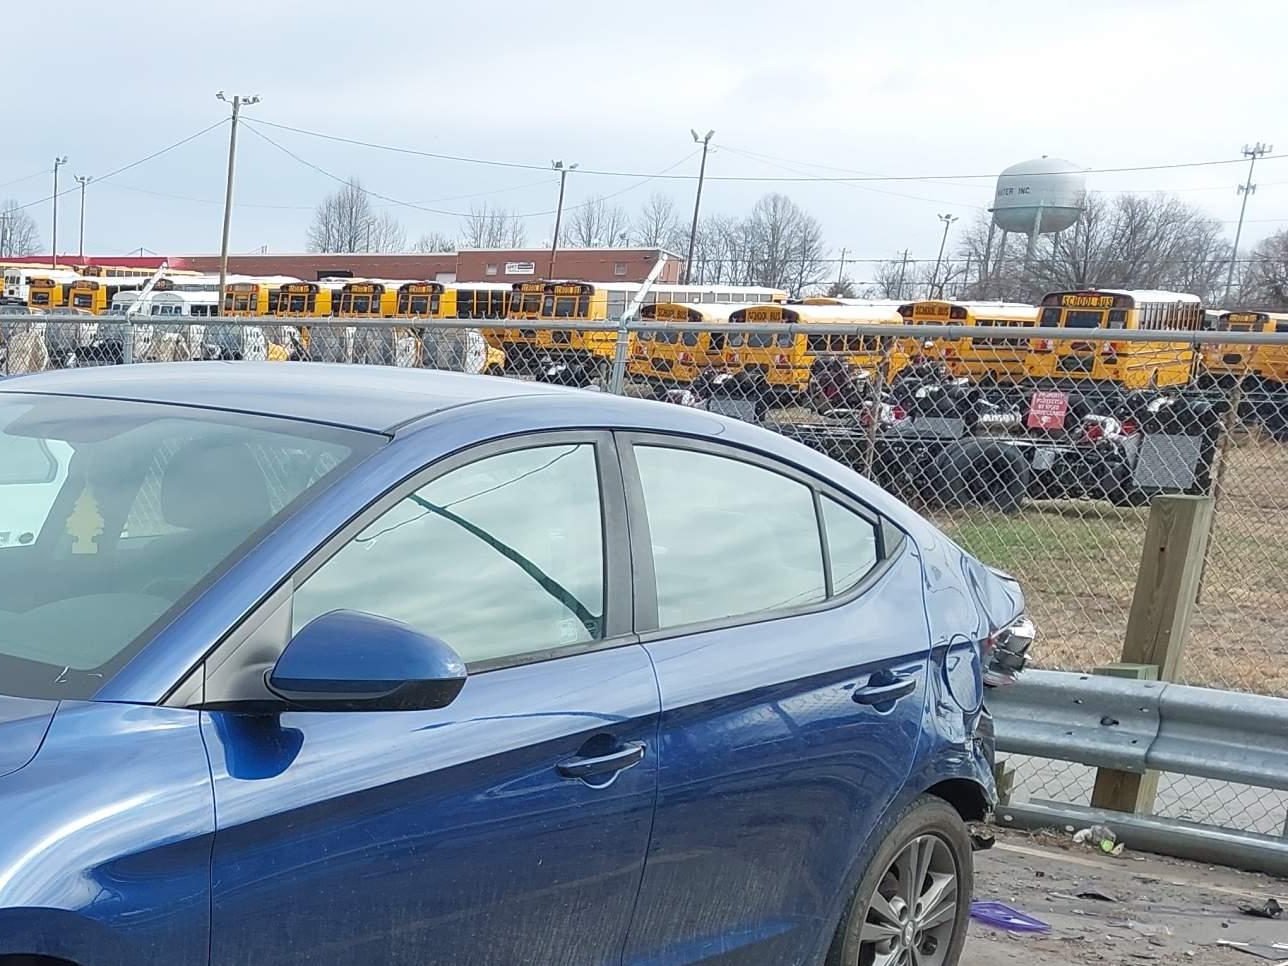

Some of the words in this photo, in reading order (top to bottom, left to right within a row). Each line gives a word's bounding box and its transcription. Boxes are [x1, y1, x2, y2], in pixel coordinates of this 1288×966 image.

[1064, 296, 1095, 306] SCHOOL
[1096, 296, 1113, 308] BUS
[748, 311, 767, 320] SCHOOL
[769, 312, 781, 321] BUS
